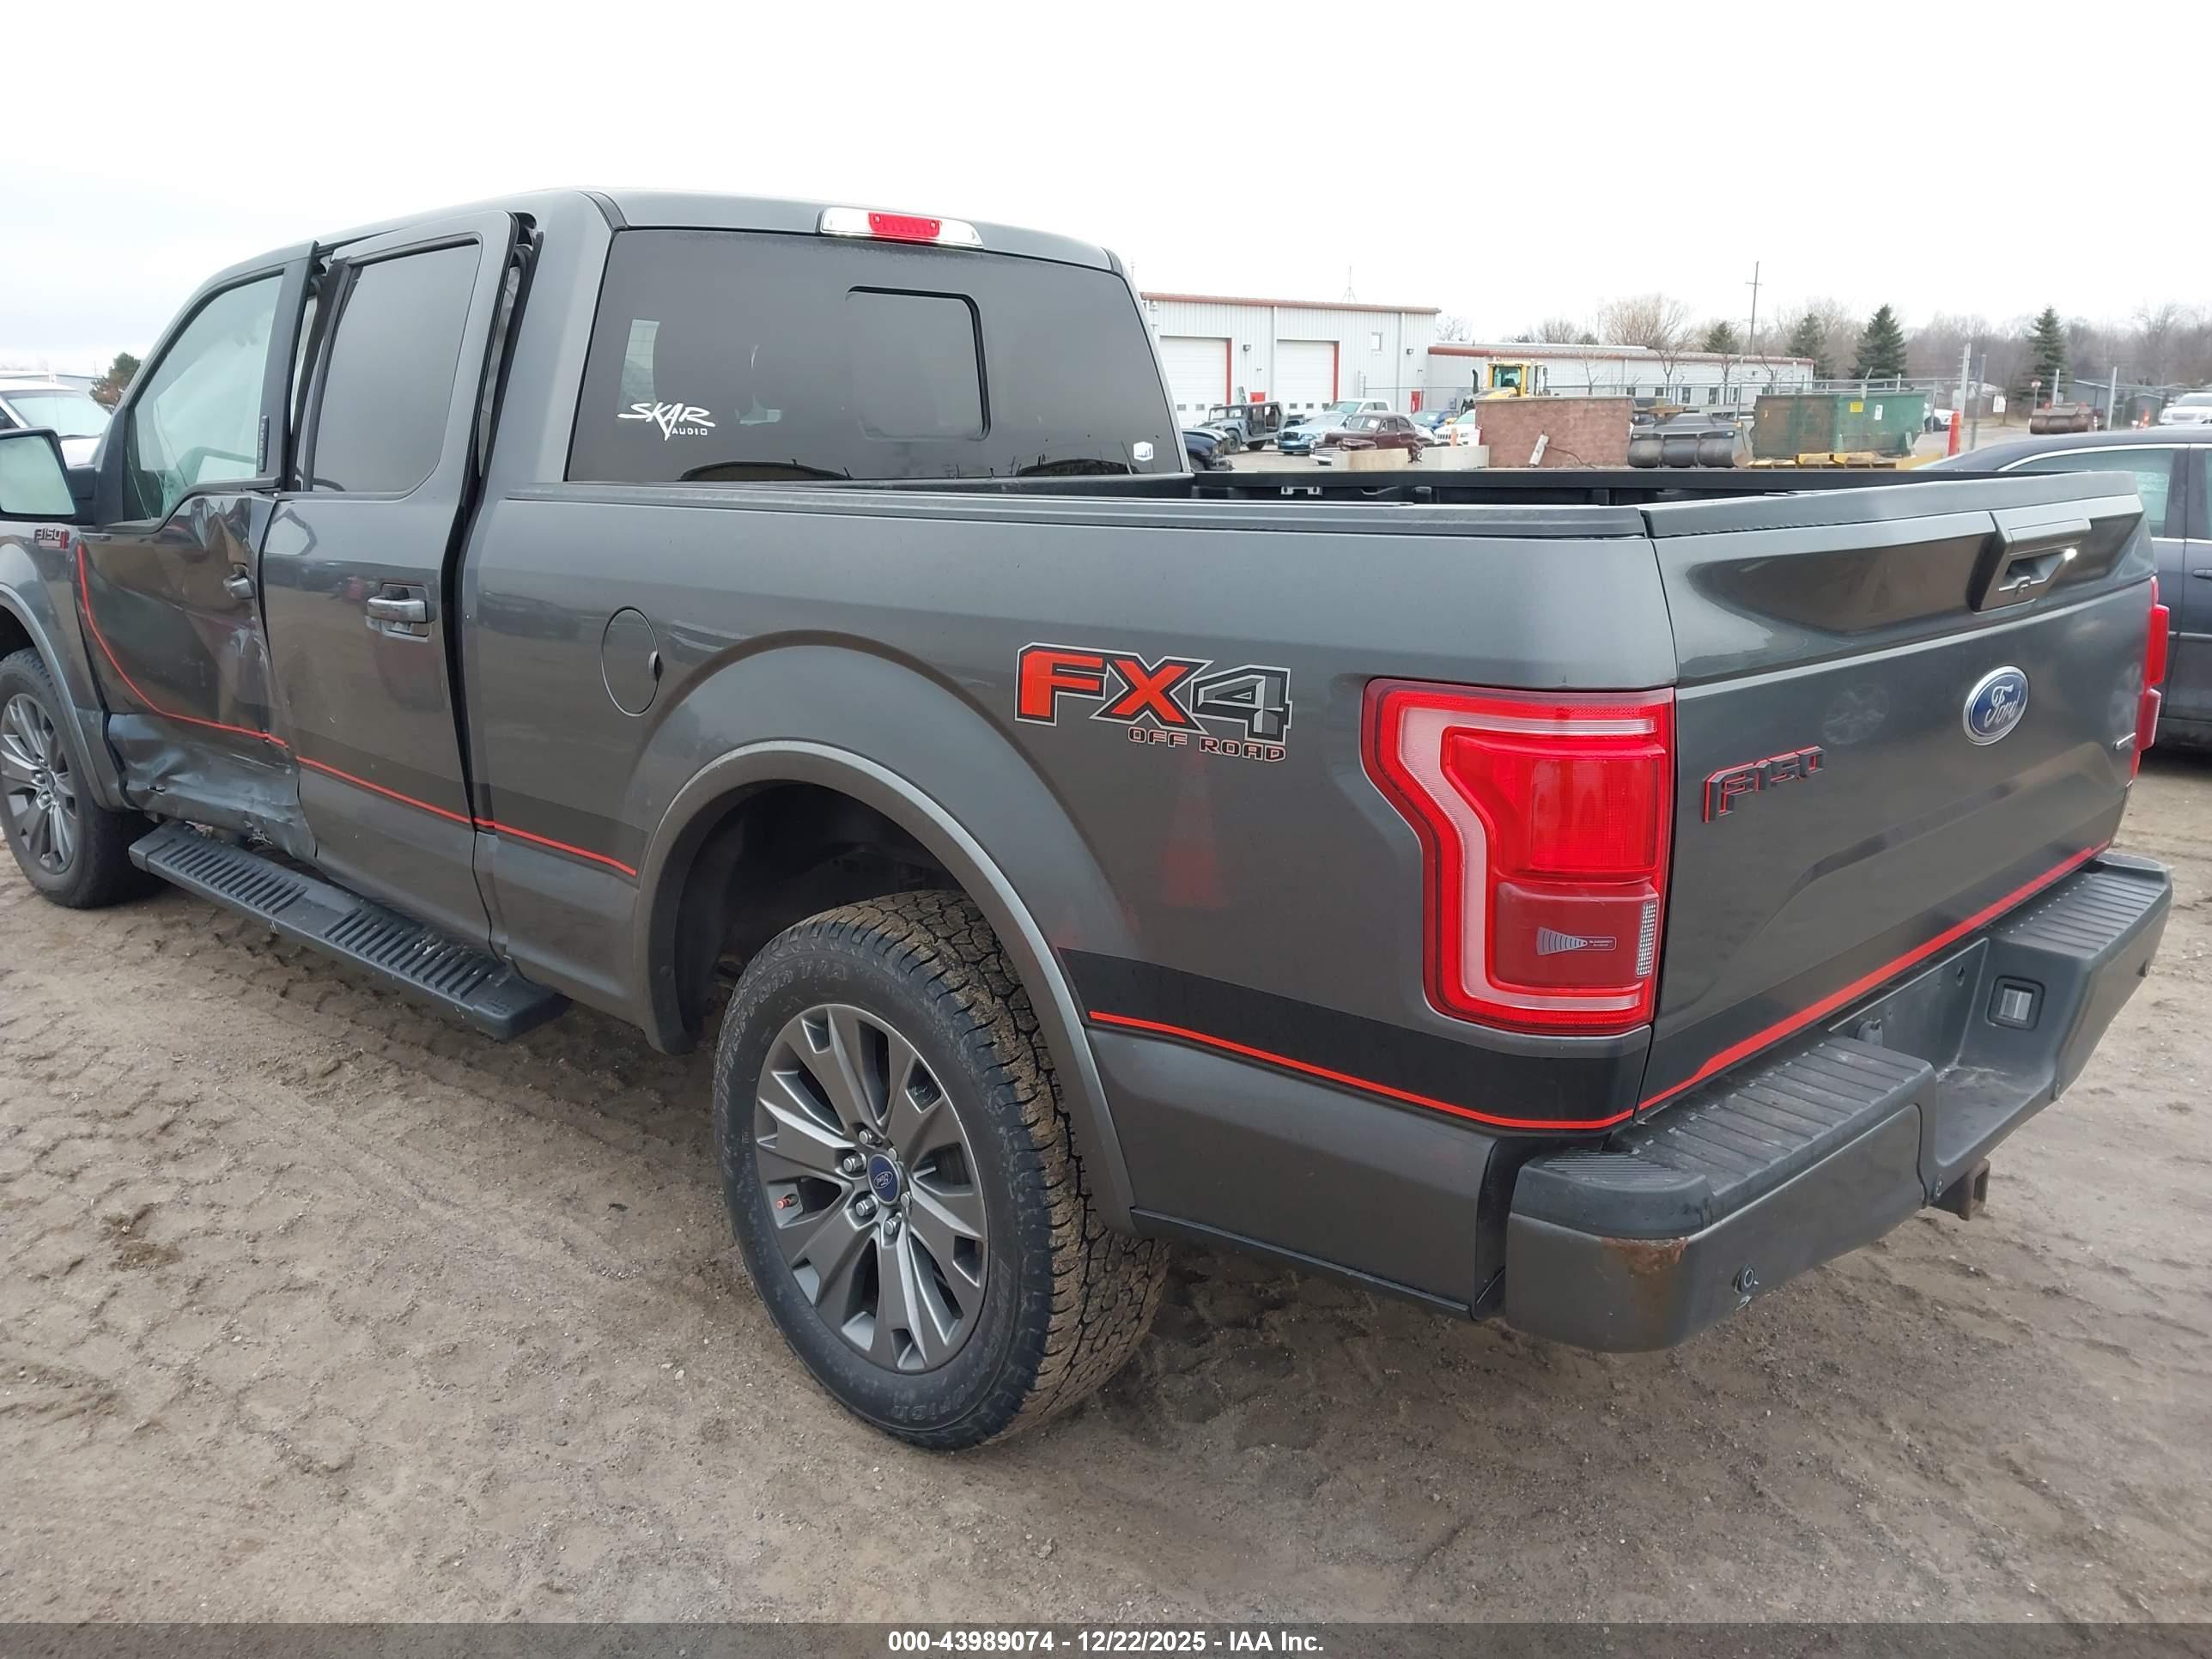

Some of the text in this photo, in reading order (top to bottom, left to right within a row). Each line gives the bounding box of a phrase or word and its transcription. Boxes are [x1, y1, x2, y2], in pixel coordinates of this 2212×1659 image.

[617, 402, 716, 441] SKAR
[672, 427, 708, 435] AUDIO
[1015, 641, 1293, 745] FX4
[1984, 684, 2021, 728] Ford
[1127, 726, 1287, 763] OFF ROAD
